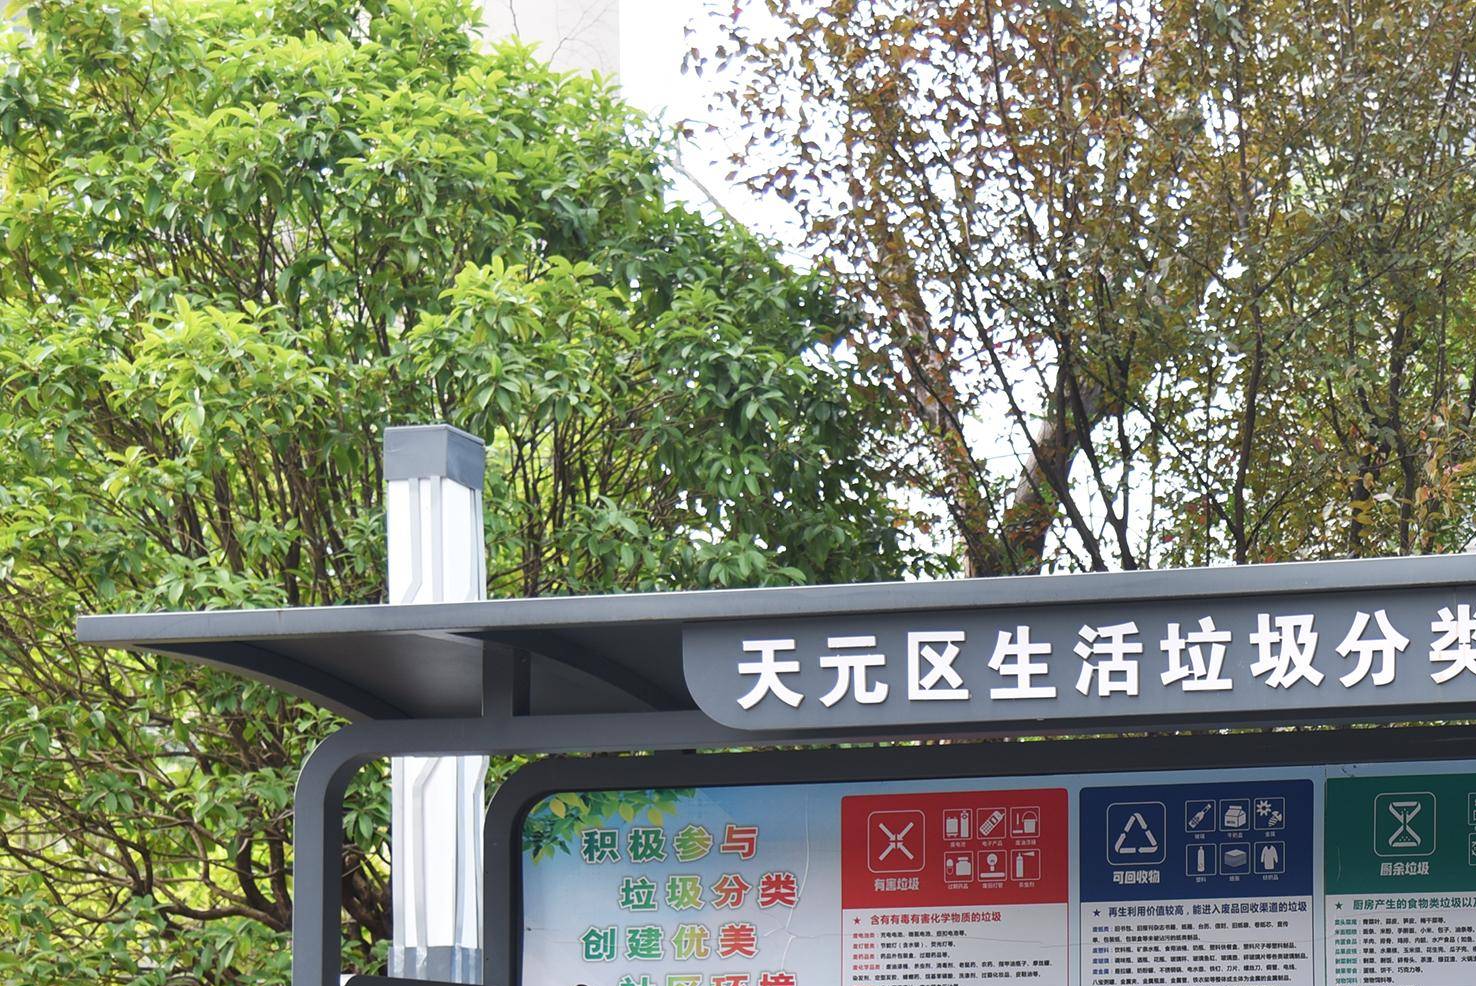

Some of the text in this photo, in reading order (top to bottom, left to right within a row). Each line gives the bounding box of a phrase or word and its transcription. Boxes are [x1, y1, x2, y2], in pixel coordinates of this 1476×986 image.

[580, 825, 760, 864] 积极参与
[1112, 870, 1160, 885] 可回收物
[1380, 862, 1430, 877] 厨余垃圾
[618, 872, 800, 912] 垃圾分类
[874, 877, 920, 892] 有害垃圾
[1108, 901, 1308, 918] 再生利用价值较高，能进入废品回收渠道的垃圾
[870, 911, 1002, 926] 含有有毒有害化学物质的垃圾
[580, 923, 759, 962] 创建优美
